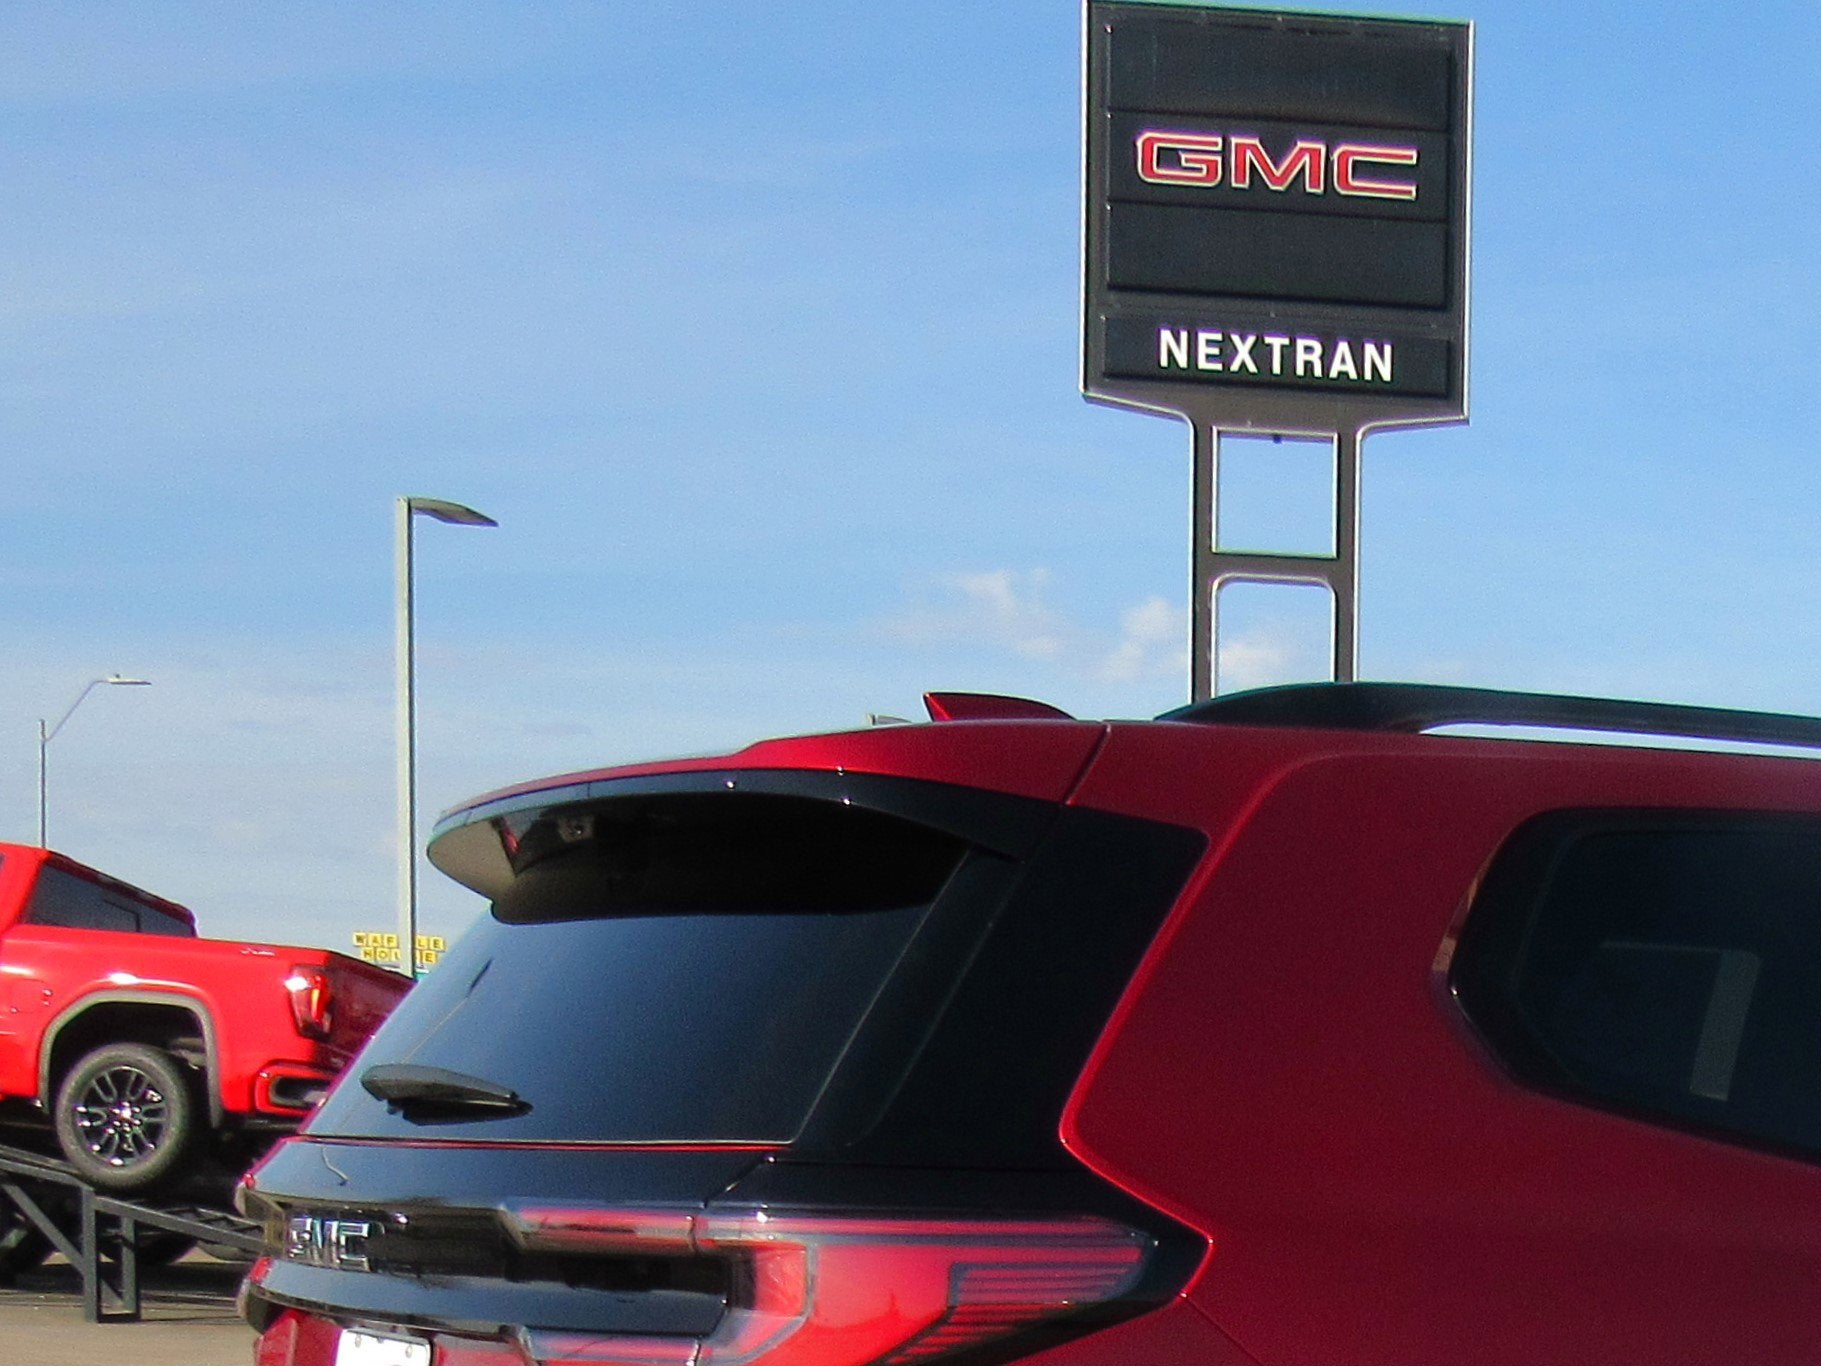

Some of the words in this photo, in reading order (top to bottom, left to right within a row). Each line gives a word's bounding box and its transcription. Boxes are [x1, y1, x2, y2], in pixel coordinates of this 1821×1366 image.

[1136, 131, 1418, 200] GMC
[1158, 328, 1393, 382] NEXTRAN
[355, 933, 442, 948] WAFLE
[287, 1217, 371, 1272] GMC
